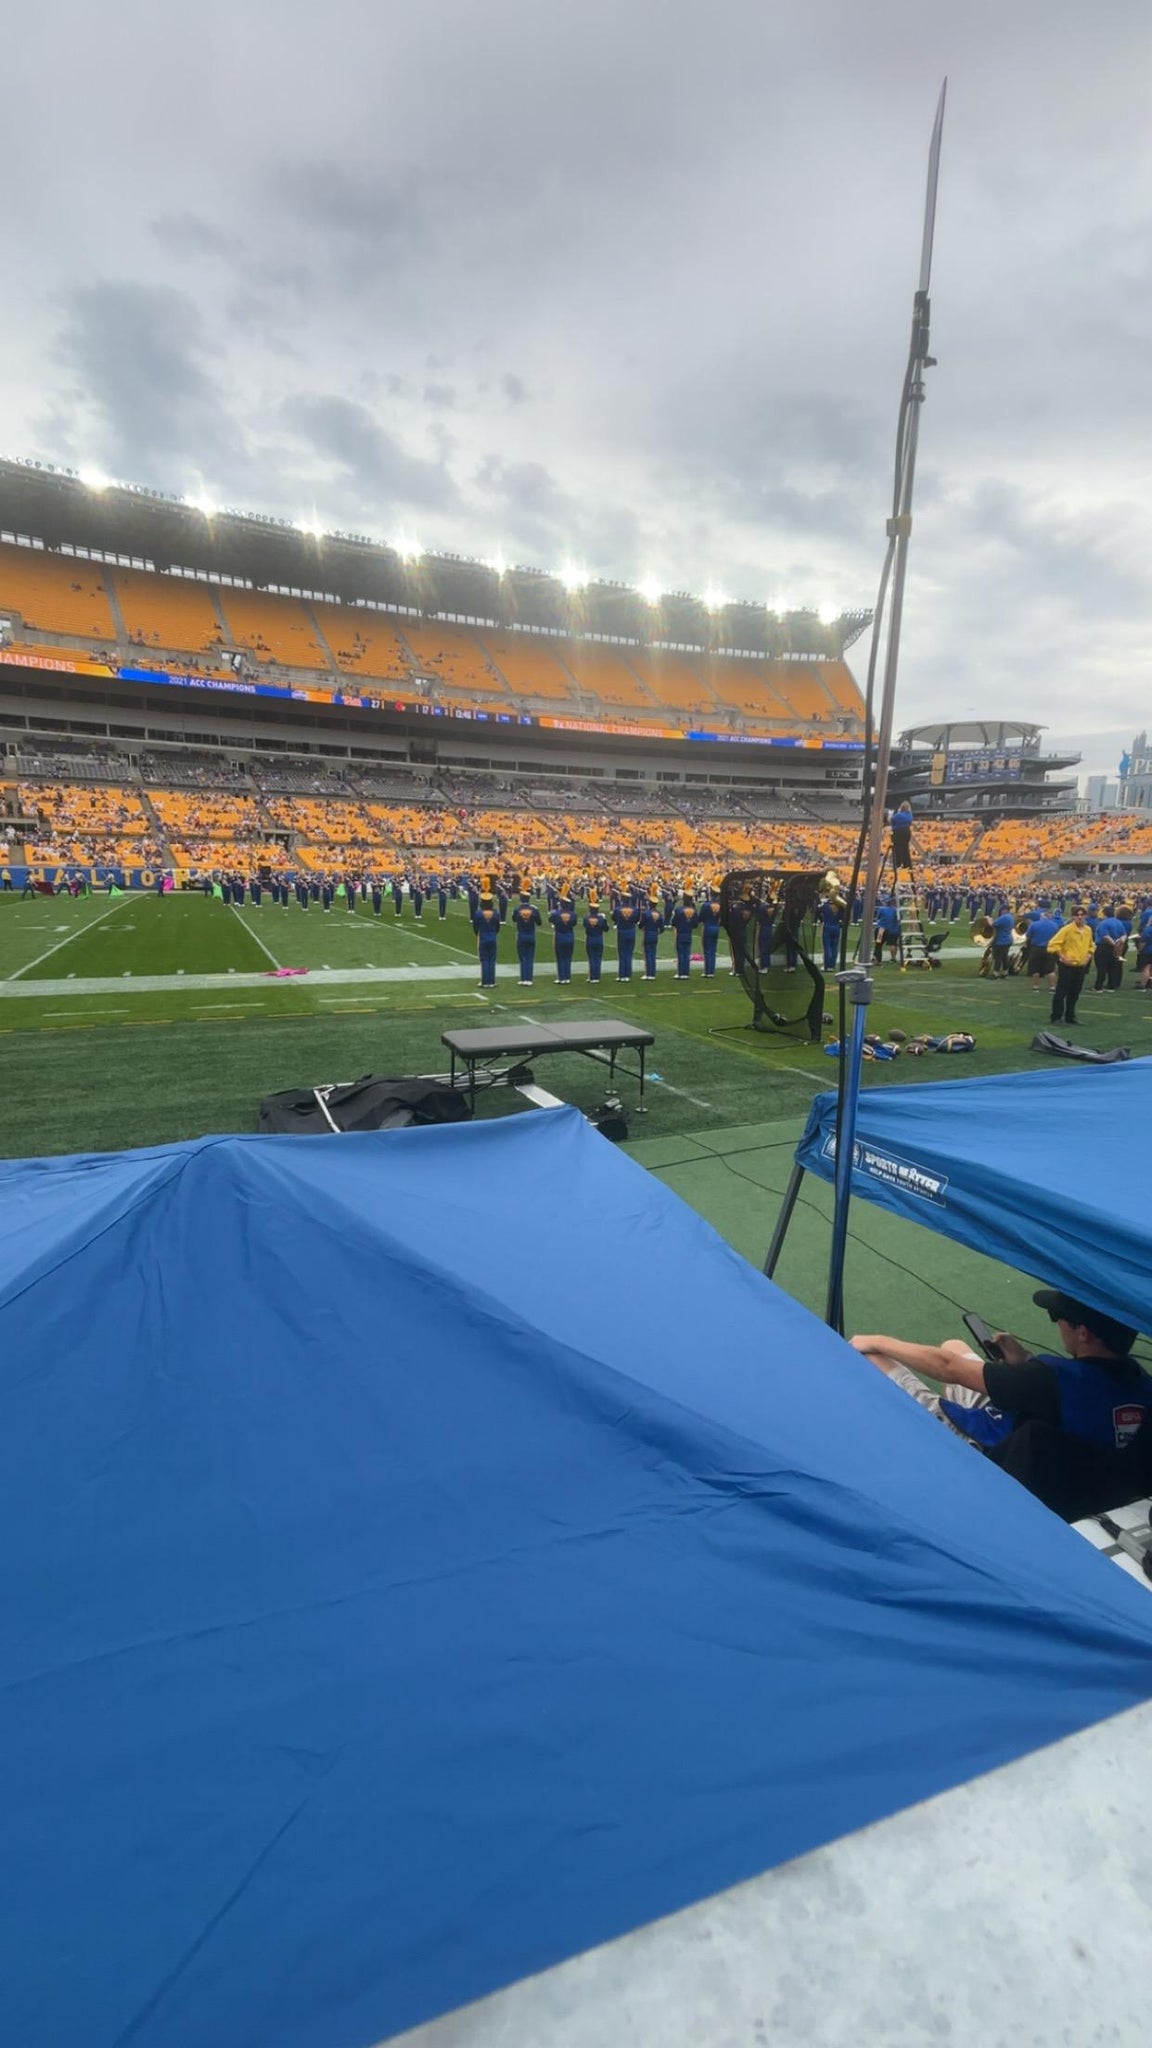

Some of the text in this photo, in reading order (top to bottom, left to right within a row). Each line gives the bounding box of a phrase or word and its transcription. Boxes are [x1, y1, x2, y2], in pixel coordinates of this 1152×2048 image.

[168, 676, 256, 694] 2021 ACC CHAMPIONS
[865, 1150, 898, 1174] SPORTS
